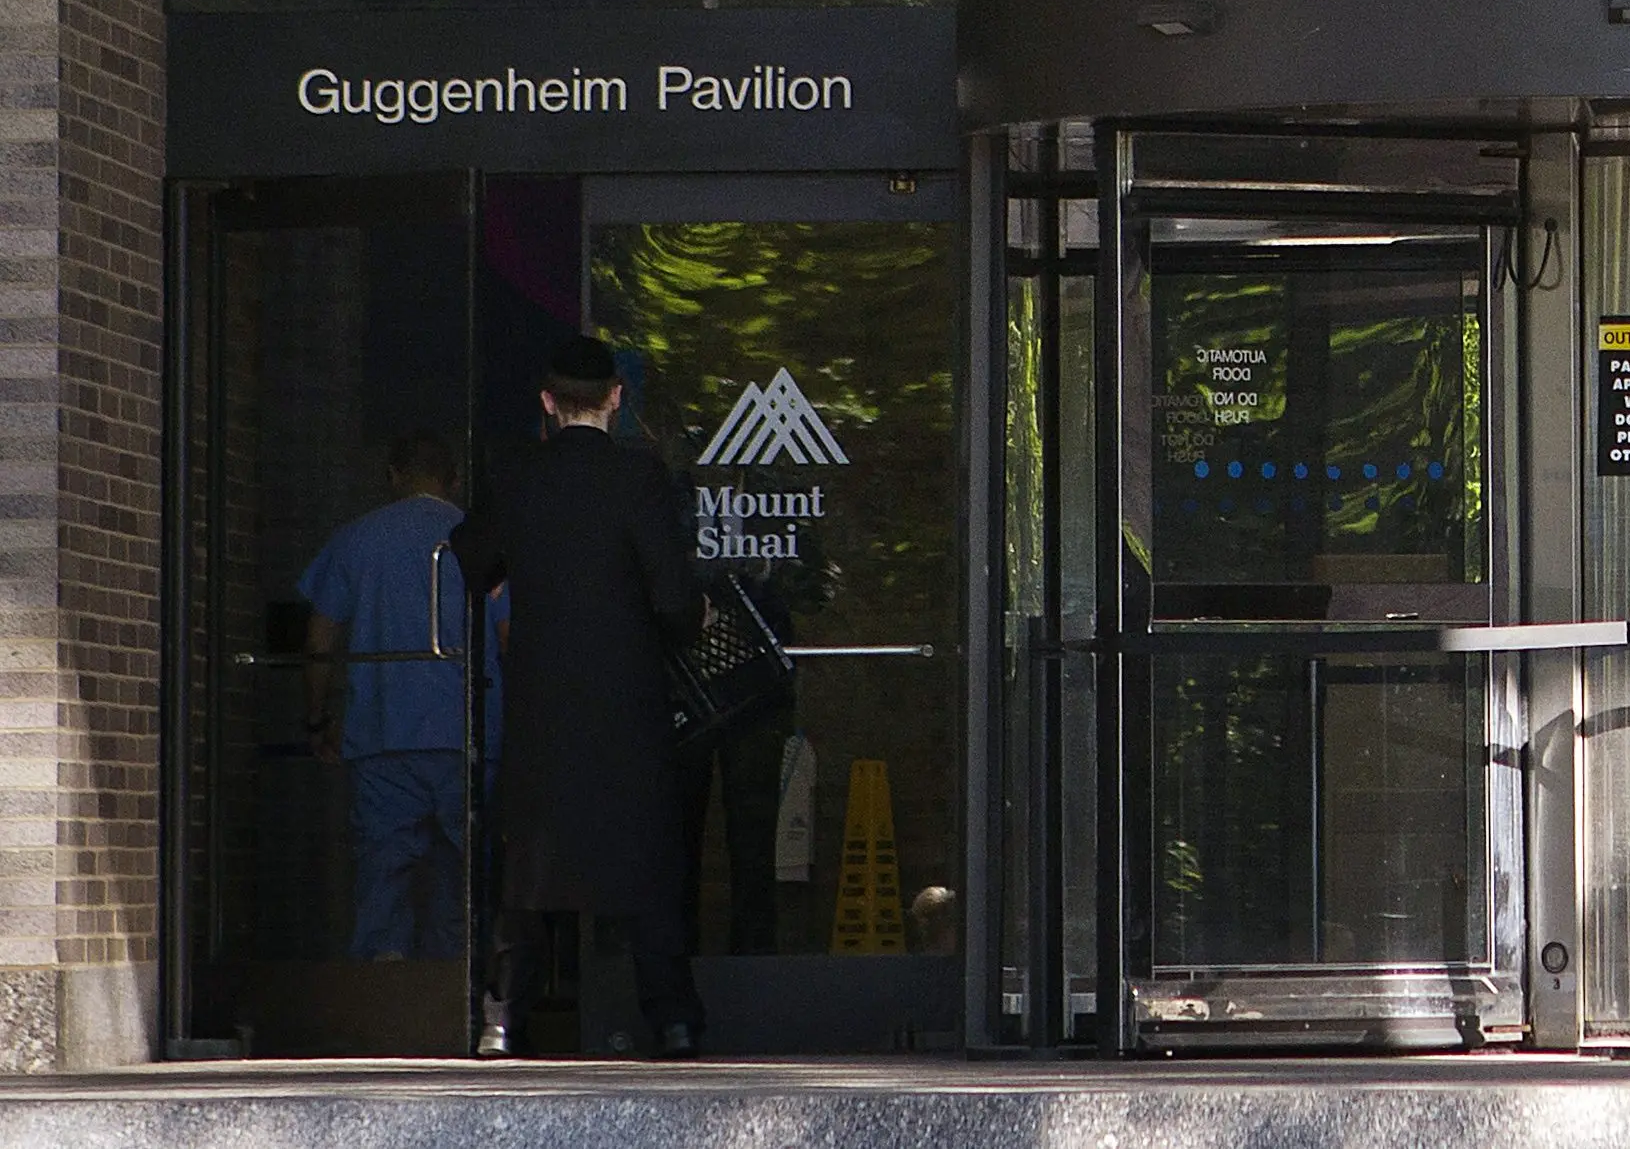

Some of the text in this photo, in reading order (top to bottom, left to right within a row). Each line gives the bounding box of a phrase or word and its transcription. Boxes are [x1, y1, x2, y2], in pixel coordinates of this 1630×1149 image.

[297, 65, 853, 125] Guggenheim Pavilion
[694, 485, 825, 518] Mount
[696, 523, 799, 559] Sinai
